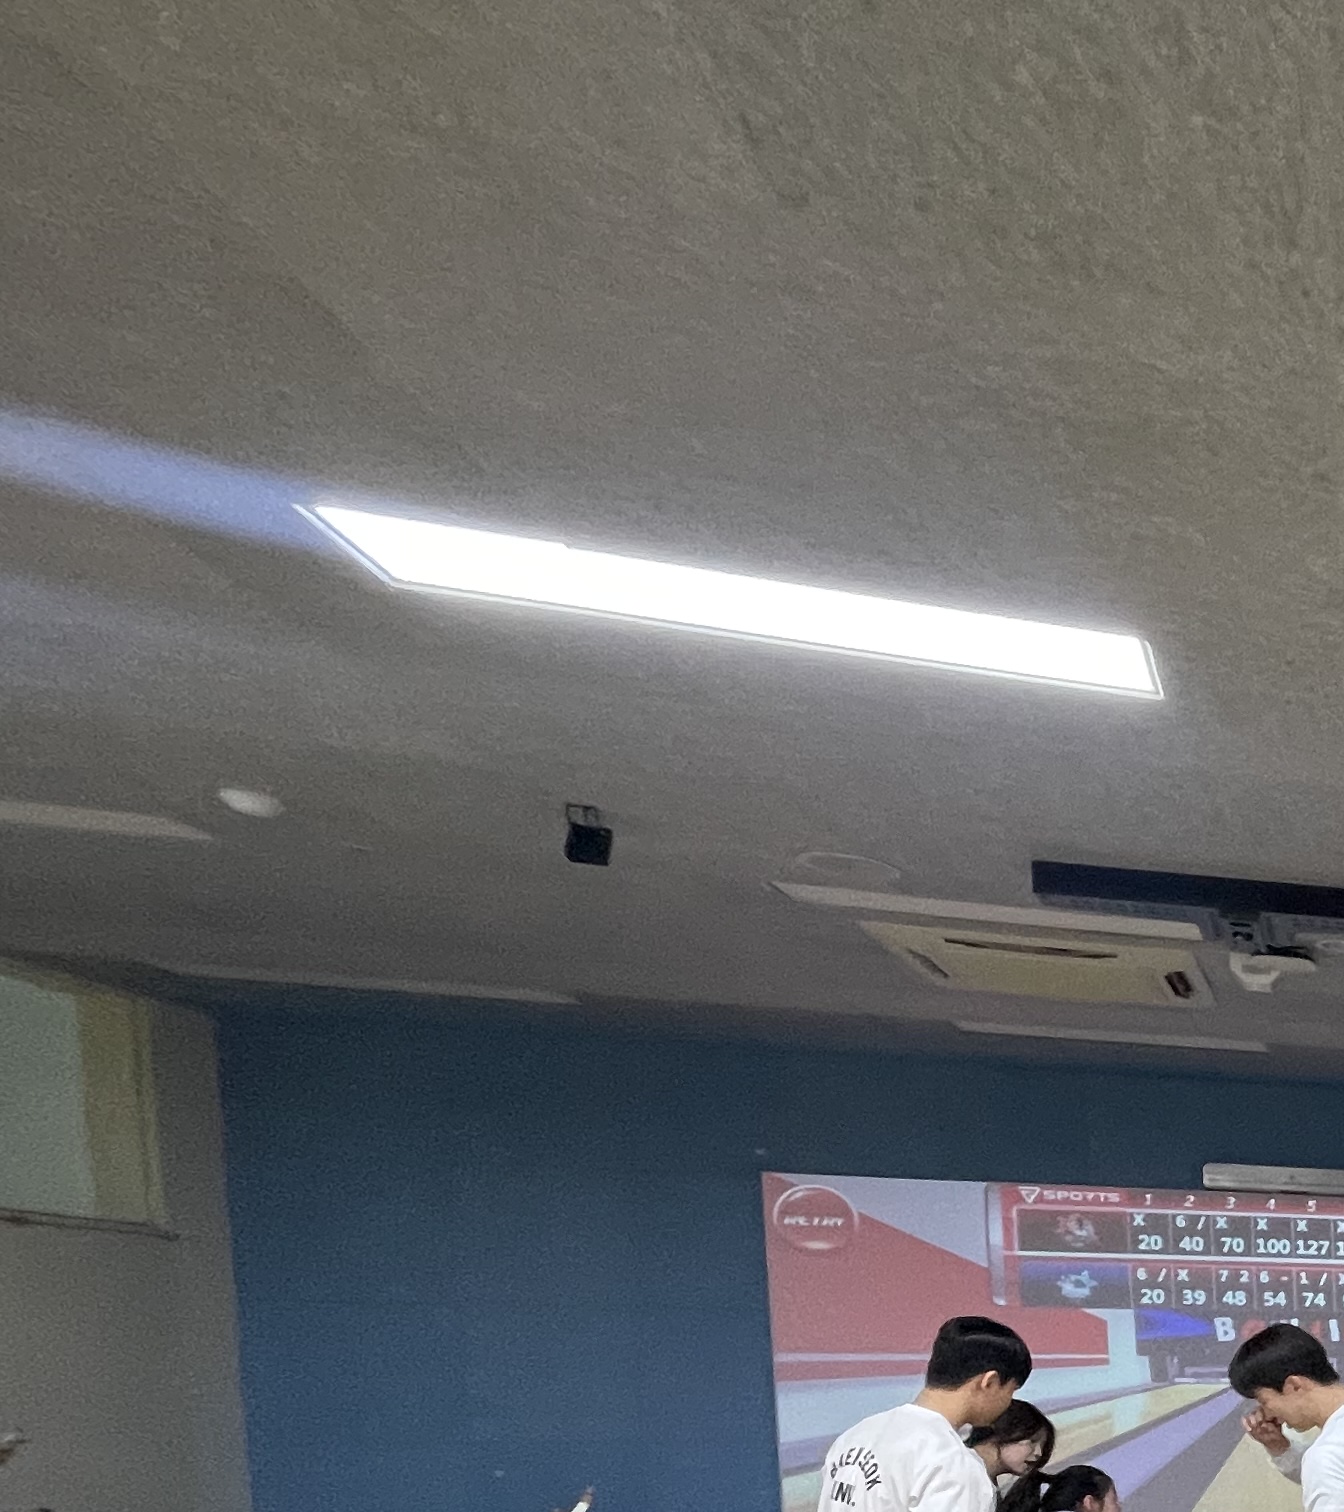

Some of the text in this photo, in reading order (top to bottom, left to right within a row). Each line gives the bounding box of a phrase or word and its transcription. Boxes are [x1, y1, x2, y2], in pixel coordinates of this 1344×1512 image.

[1145, 1194, 1152, 1206] 1
[1184, 1195, 1195, 1207] 2
[1225, 1196, 1236, 1209] 3
[1266, 1198, 1276, 1211] 4
[1306, 1200, 1317, 1212] 5
[1133, 1213, 1146, 1226] X
[1175, 1215, 1186, 1227] 6
[1215, 1216, 1228, 1229] X
[1256, 1218, 1268, 1231] X
[1296, 1219, 1308, 1232] X
[1138, 1234, 1163, 1251] 20
[1178, 1235, 1205, 1252] 40
[1220, 1237, 1245, 1253] 70
[1256, 1238, 1291, 1254] 100
[1296, 1240, 1330, 1255] 127
[1136, 1268, 1148, 1281] 6
[1177, 1269, 1189, 1282] X
[1218, 1269, 1229, 1282] 7
[1239, 1270, 1250, 1283] 2
[1259, 1270, 1270, 1283] 6
[1300, 1271, 1308, 1285] 1
[1140, 1288, 1166, 1304] 20
[1182, 1289, 1207, 1305] 39
[1222, 1290, 1248, 1306] 48
[1263, 1291, 1287, 1307] 54
[1302, 1292, 1327, 1307] 74
